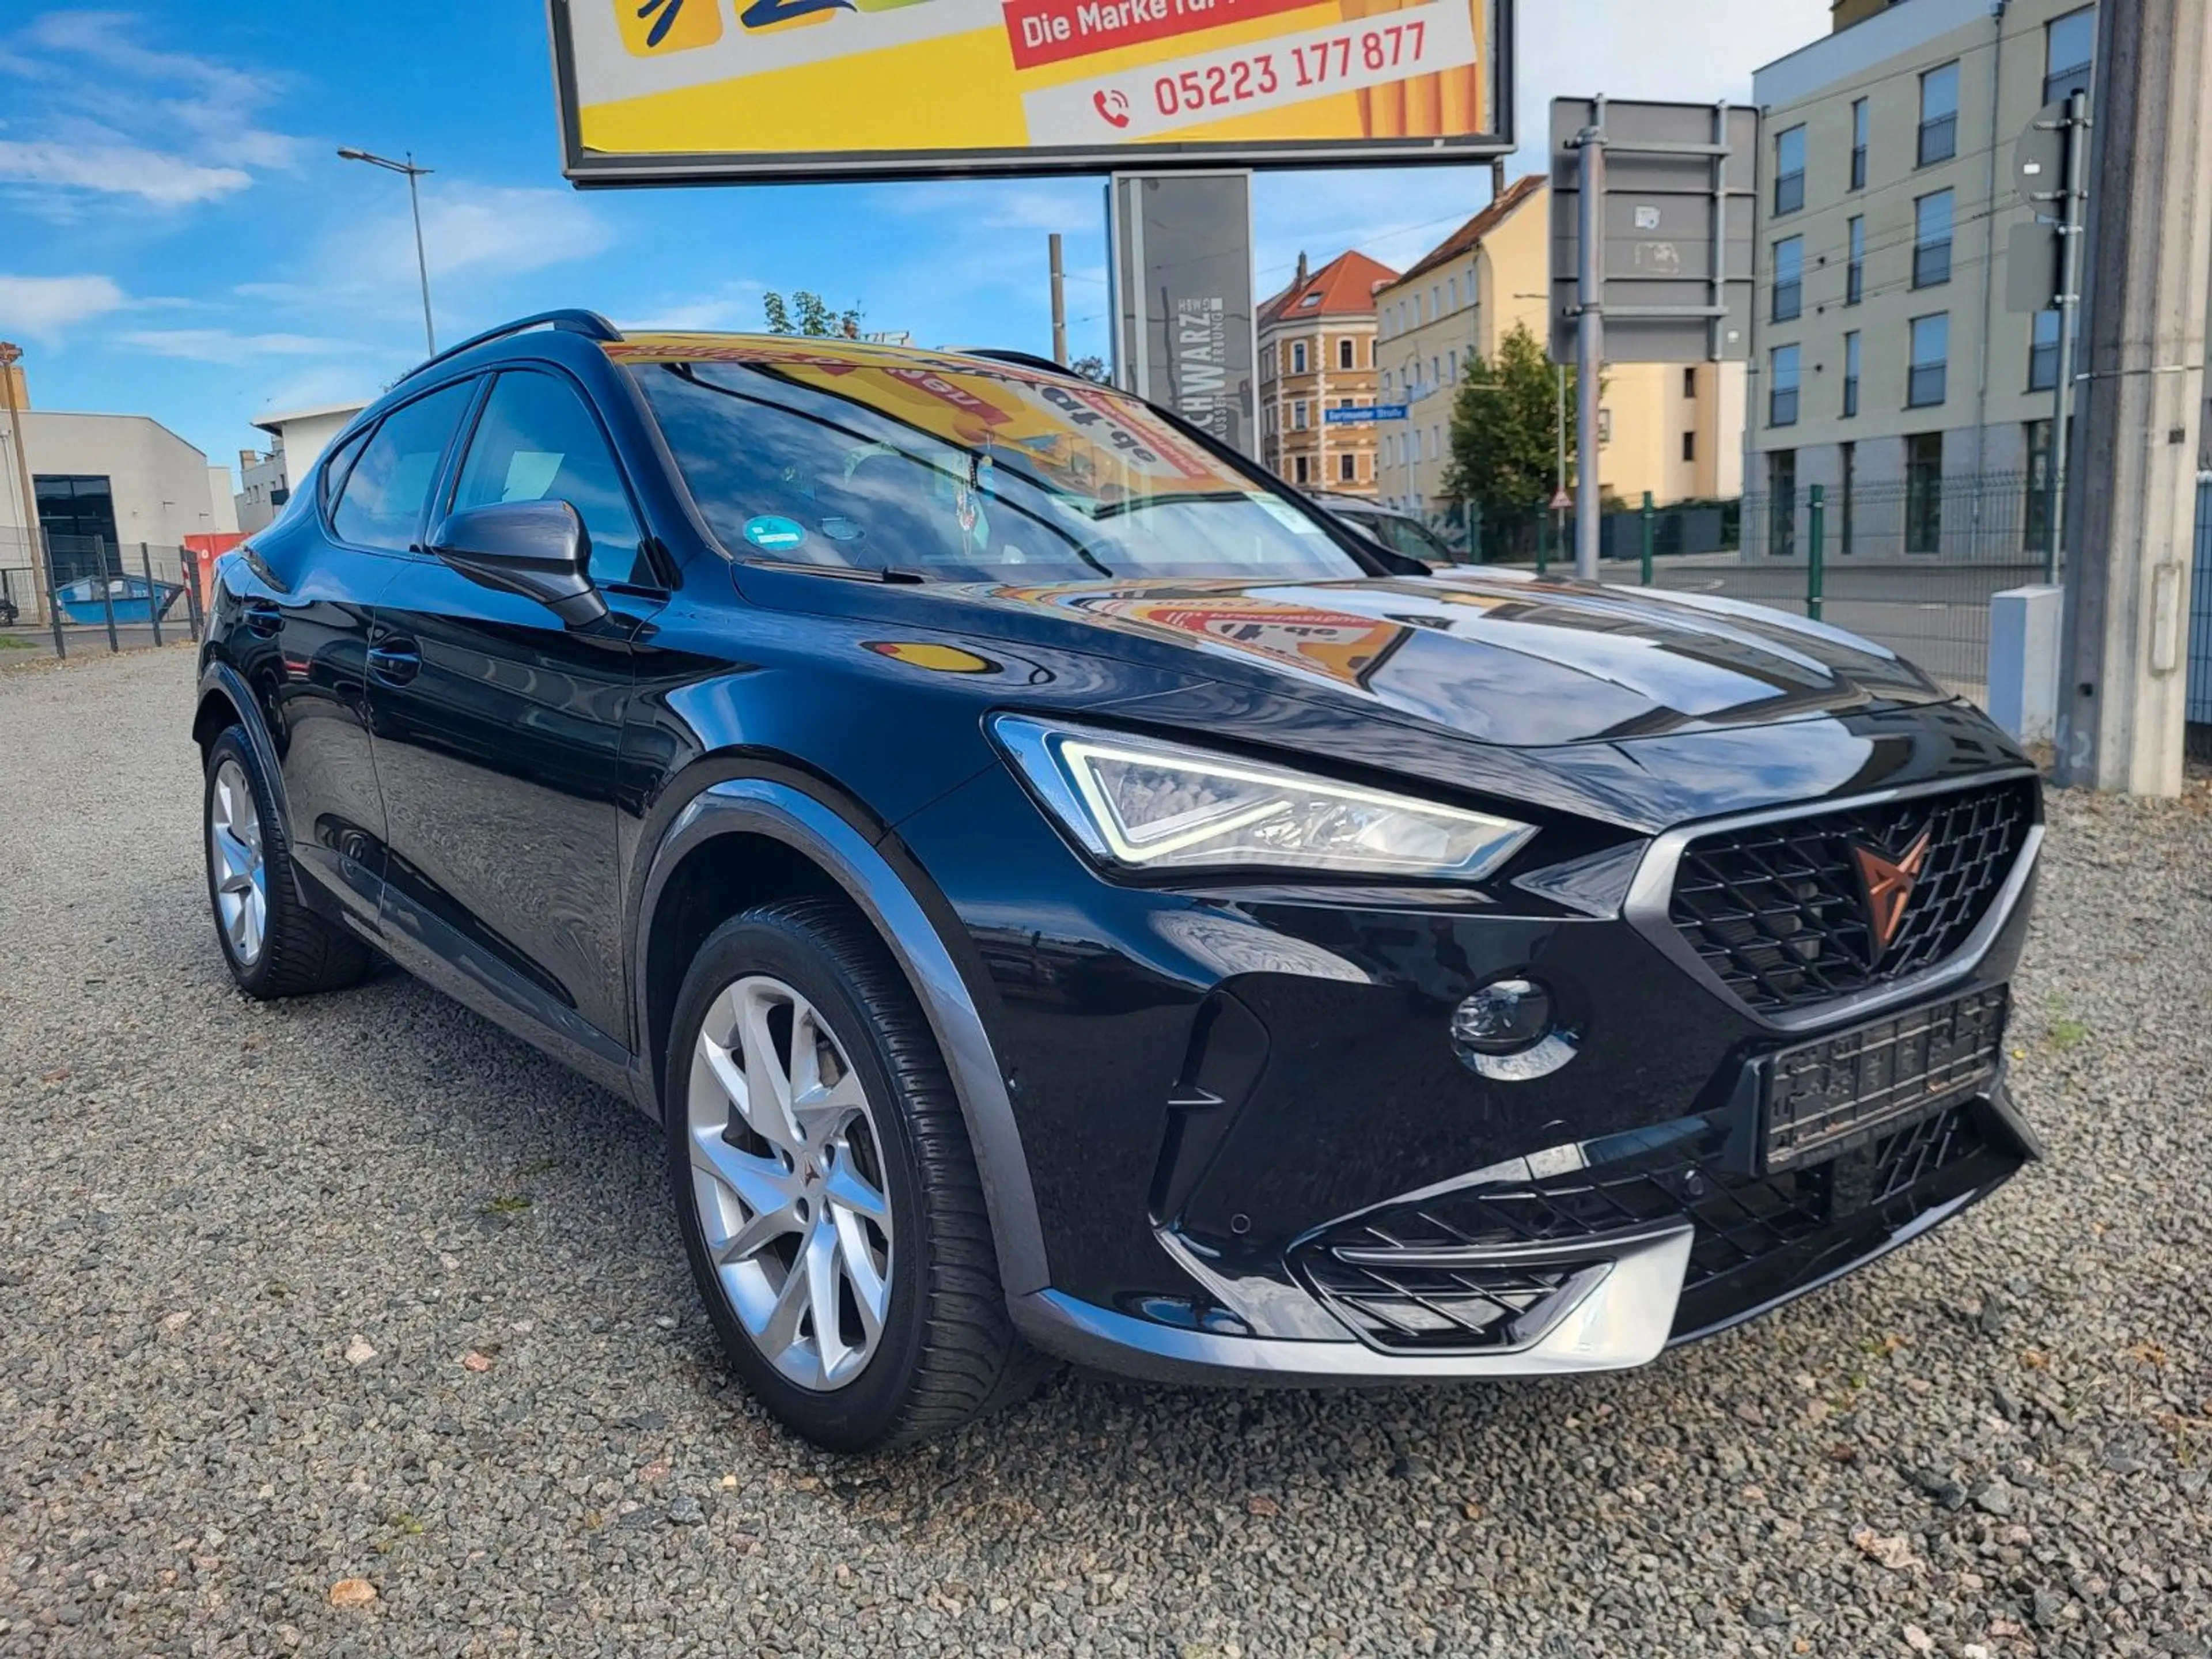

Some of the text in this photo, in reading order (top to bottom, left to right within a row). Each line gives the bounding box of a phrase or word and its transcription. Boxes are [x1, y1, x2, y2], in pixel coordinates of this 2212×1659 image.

[1021, 13, 1070, 48] Die
[1076, 0, 1168, 36] Marke
[1154, 21, 1426, 116] 05223 177 877
[1179, 313, 1225, 436] CHWARZ
